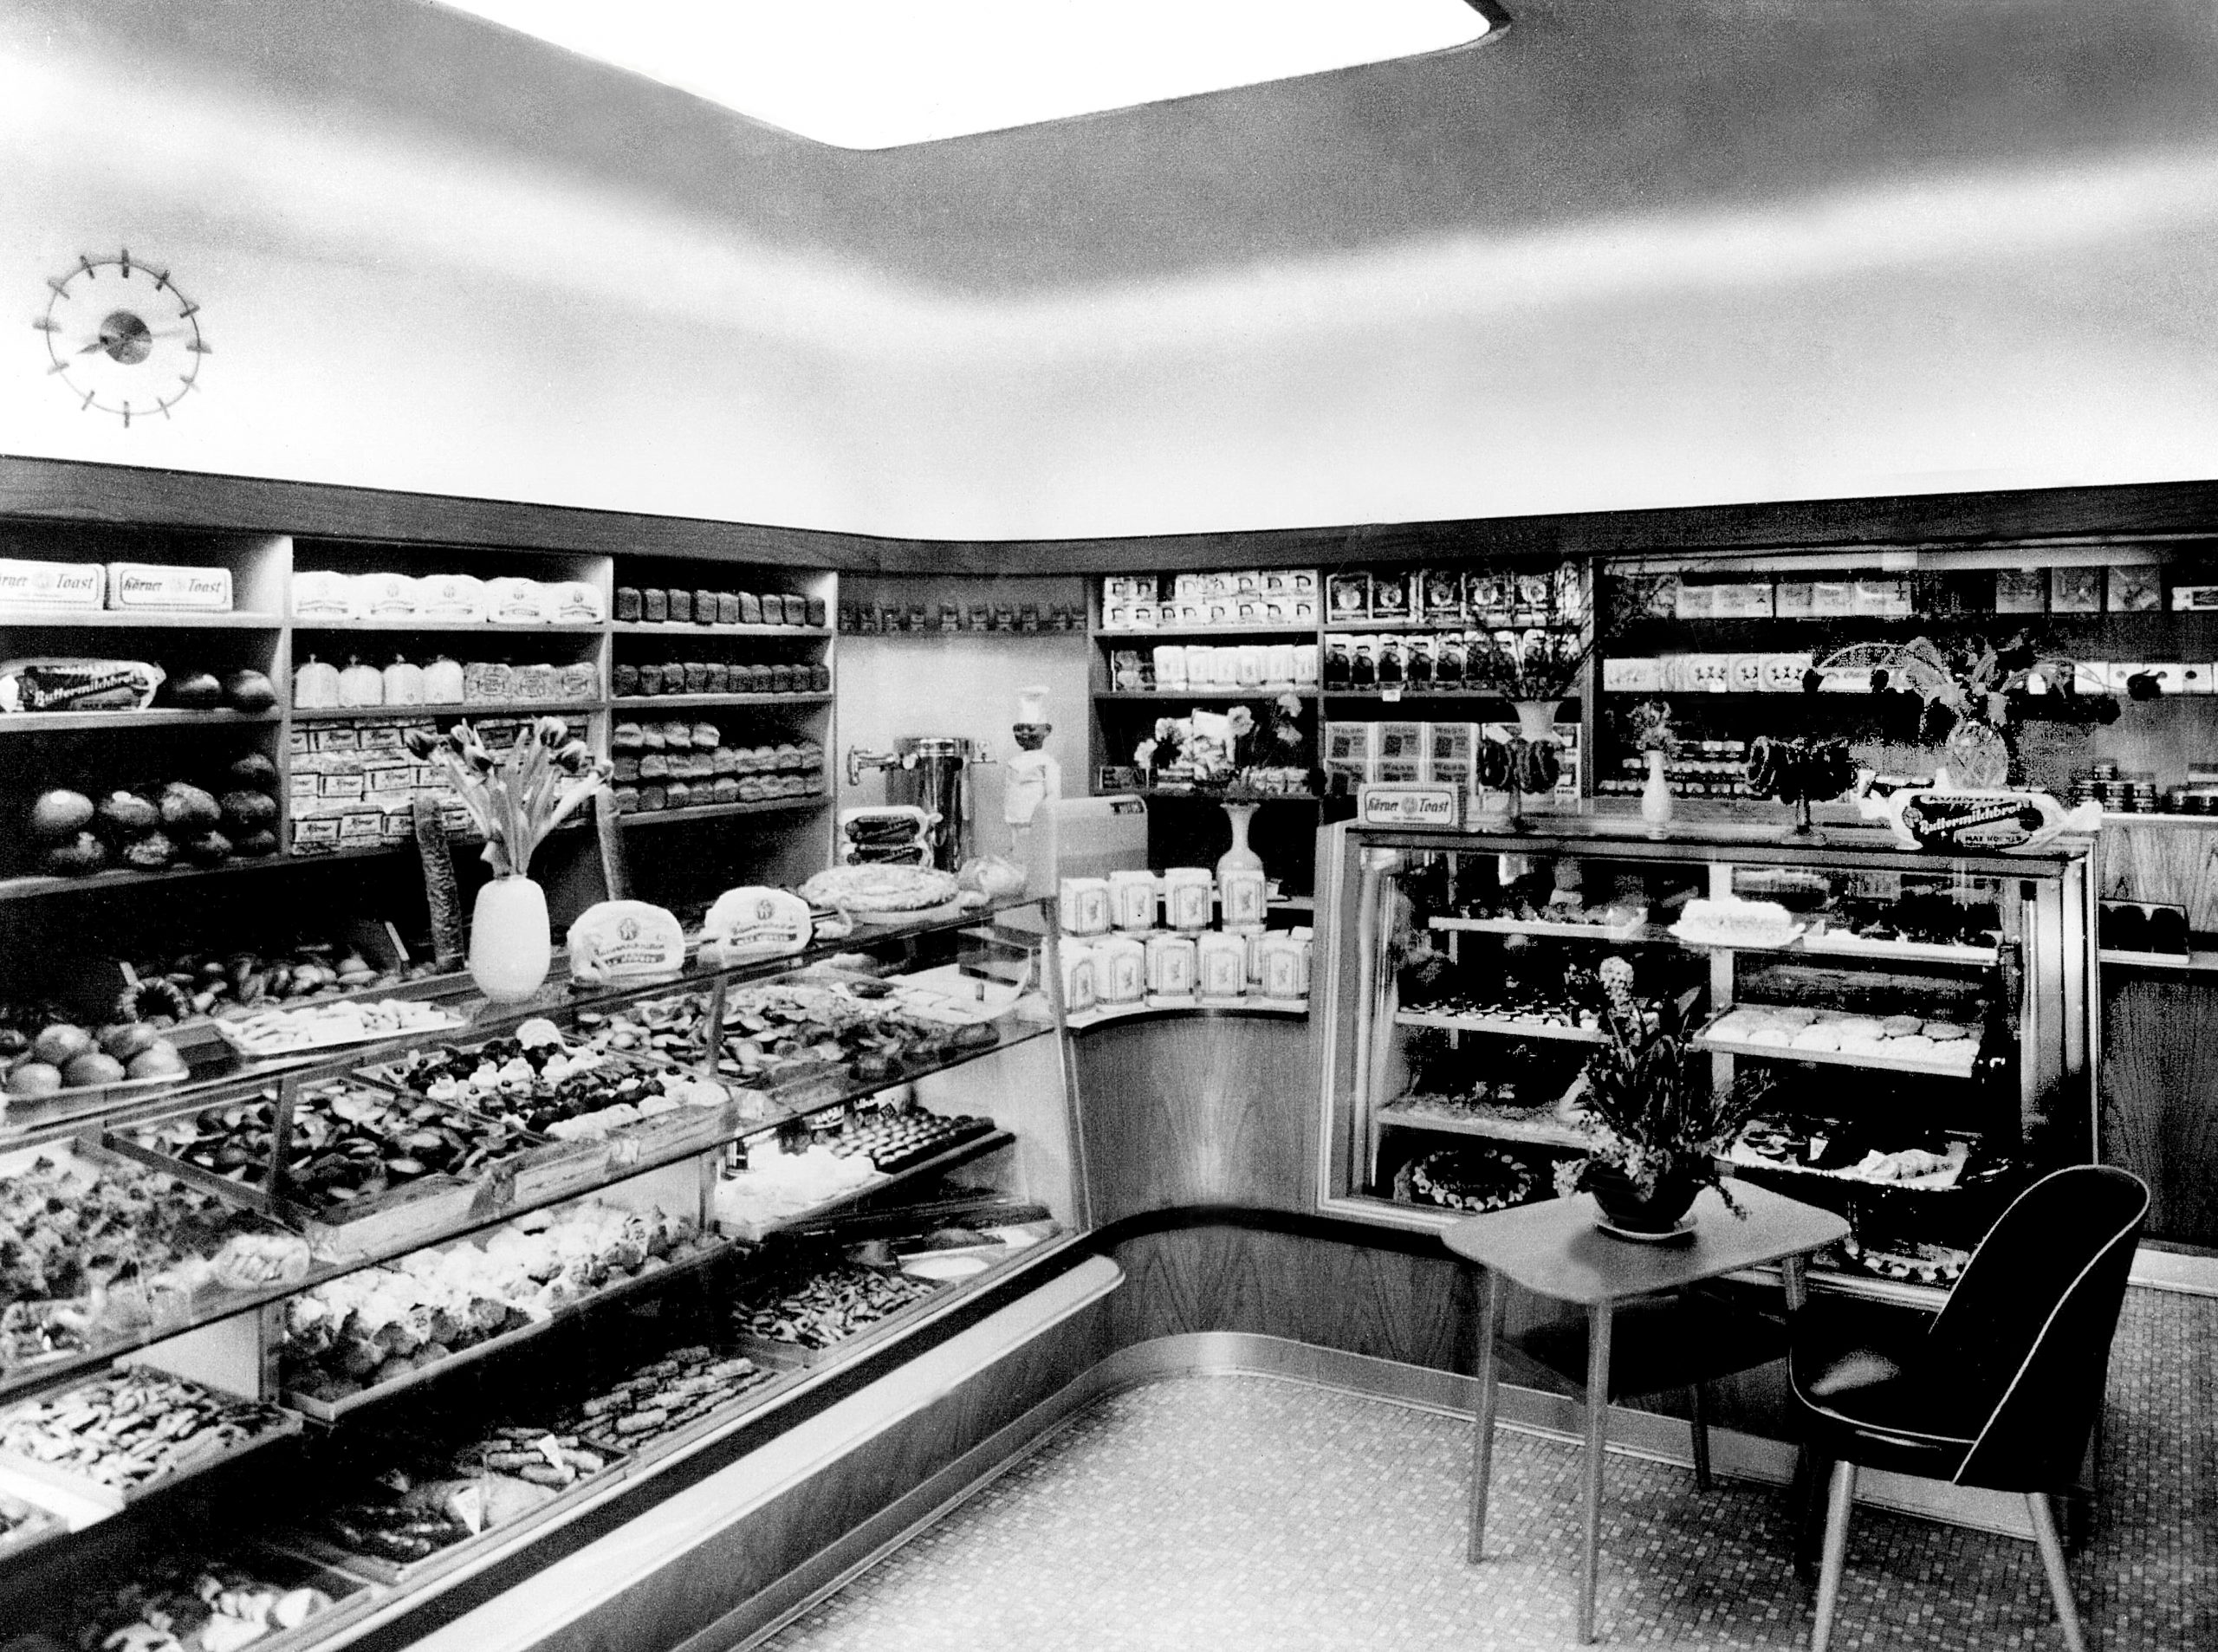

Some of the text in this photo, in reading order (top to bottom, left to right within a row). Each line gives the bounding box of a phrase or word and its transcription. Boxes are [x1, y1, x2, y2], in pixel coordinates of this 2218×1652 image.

[56, 573, 94, 590] Toast
[123, 575, 222, 593] Körner Toast
[1368, 797, 1449, 813] Körner Toast
[1919, 801, 2023, 835] Buttermilchbrot
